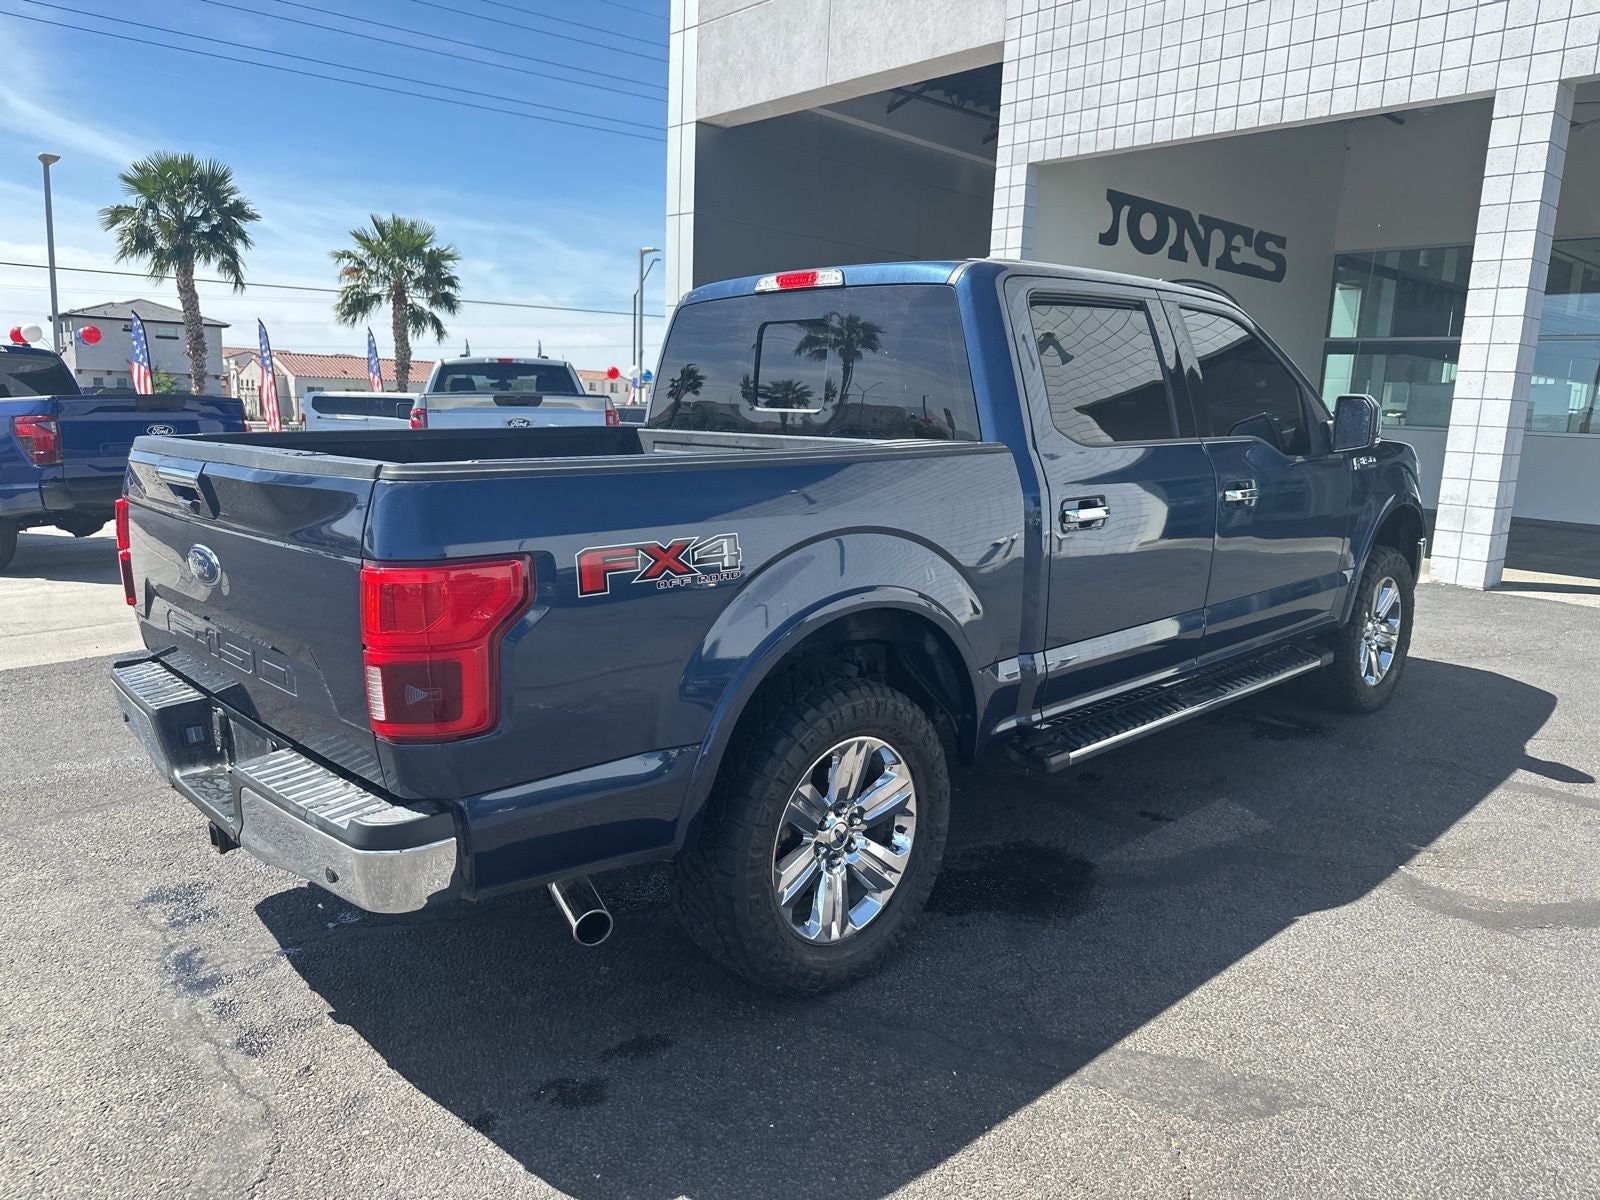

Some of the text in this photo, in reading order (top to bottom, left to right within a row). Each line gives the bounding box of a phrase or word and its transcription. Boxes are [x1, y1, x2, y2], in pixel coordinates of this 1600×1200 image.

[1098, 188, 1287, 283] JONES
[151, 426, 169, 435] Ford
[511, 419, 529, 427] Ford
[575, 533, 742, 598] FX4
[656, 571, 741, 589] OFF ROAD
